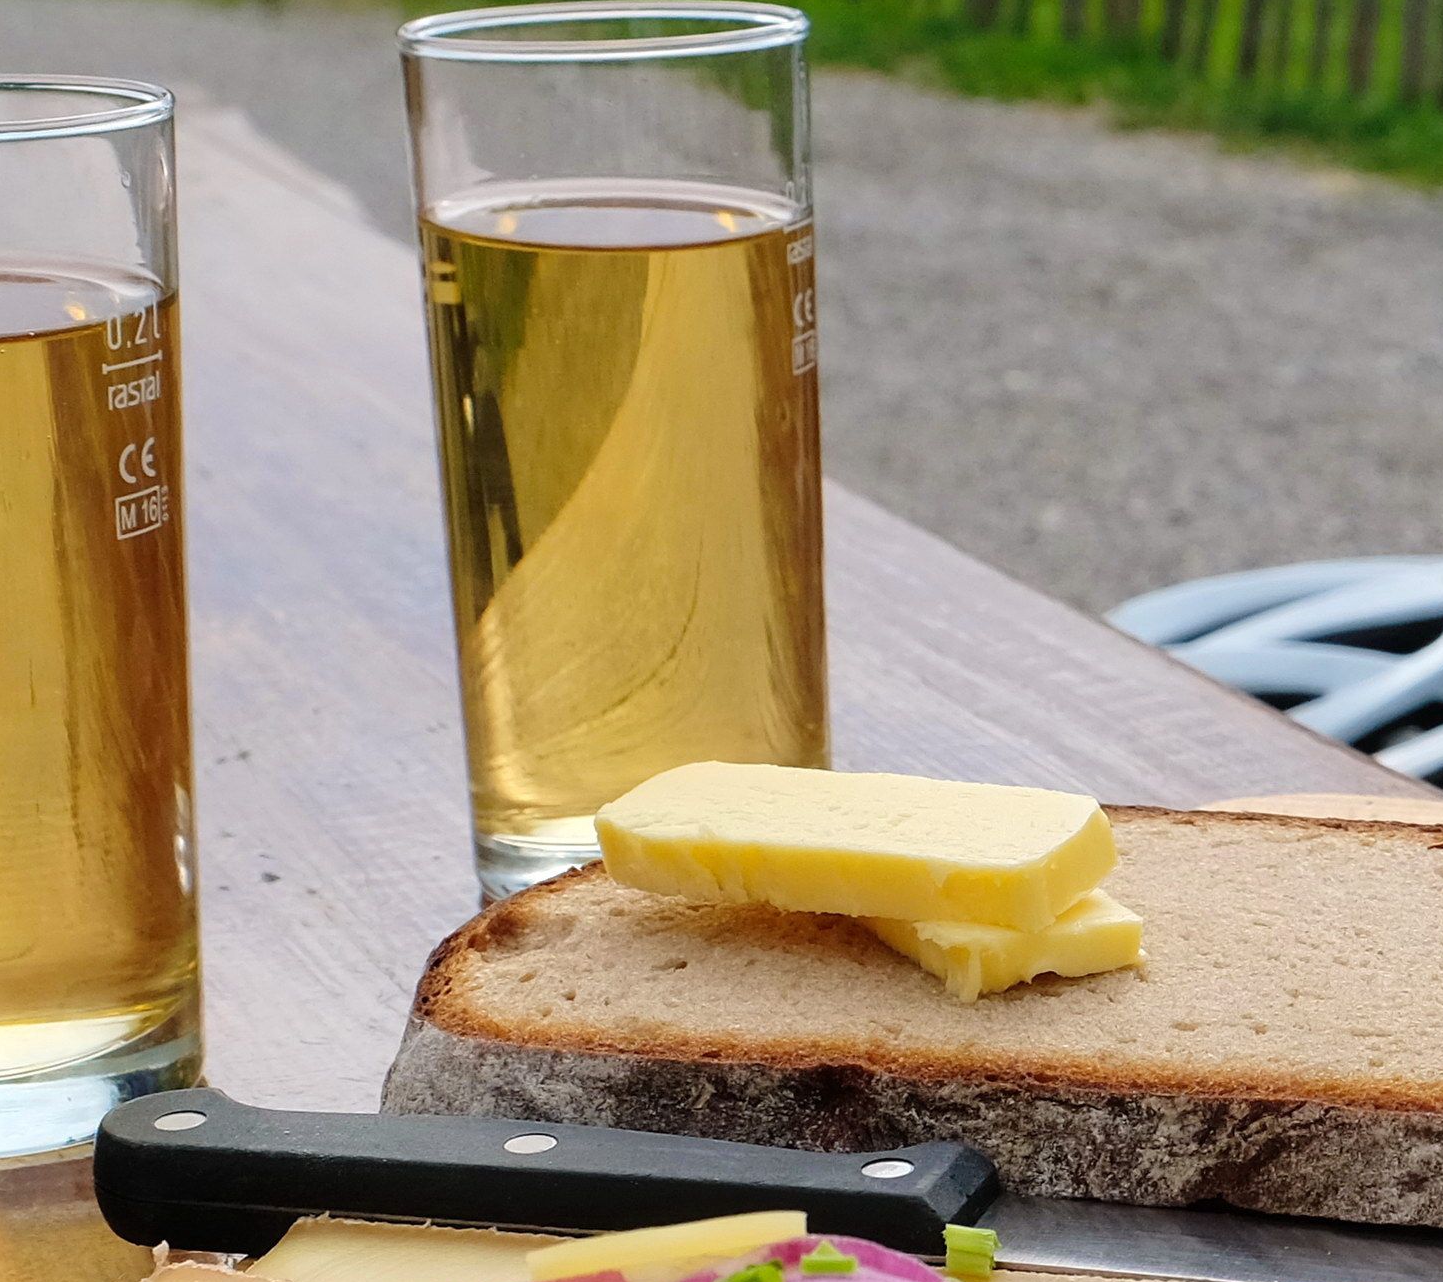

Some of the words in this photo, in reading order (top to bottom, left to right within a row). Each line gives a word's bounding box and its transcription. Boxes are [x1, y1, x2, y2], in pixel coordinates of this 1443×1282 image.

[108, 371, 162, 410] rastal
[119, 436, 157, 484] CE
[121, 503, 138, 531] M
[142, 495, 160, 524] 16
